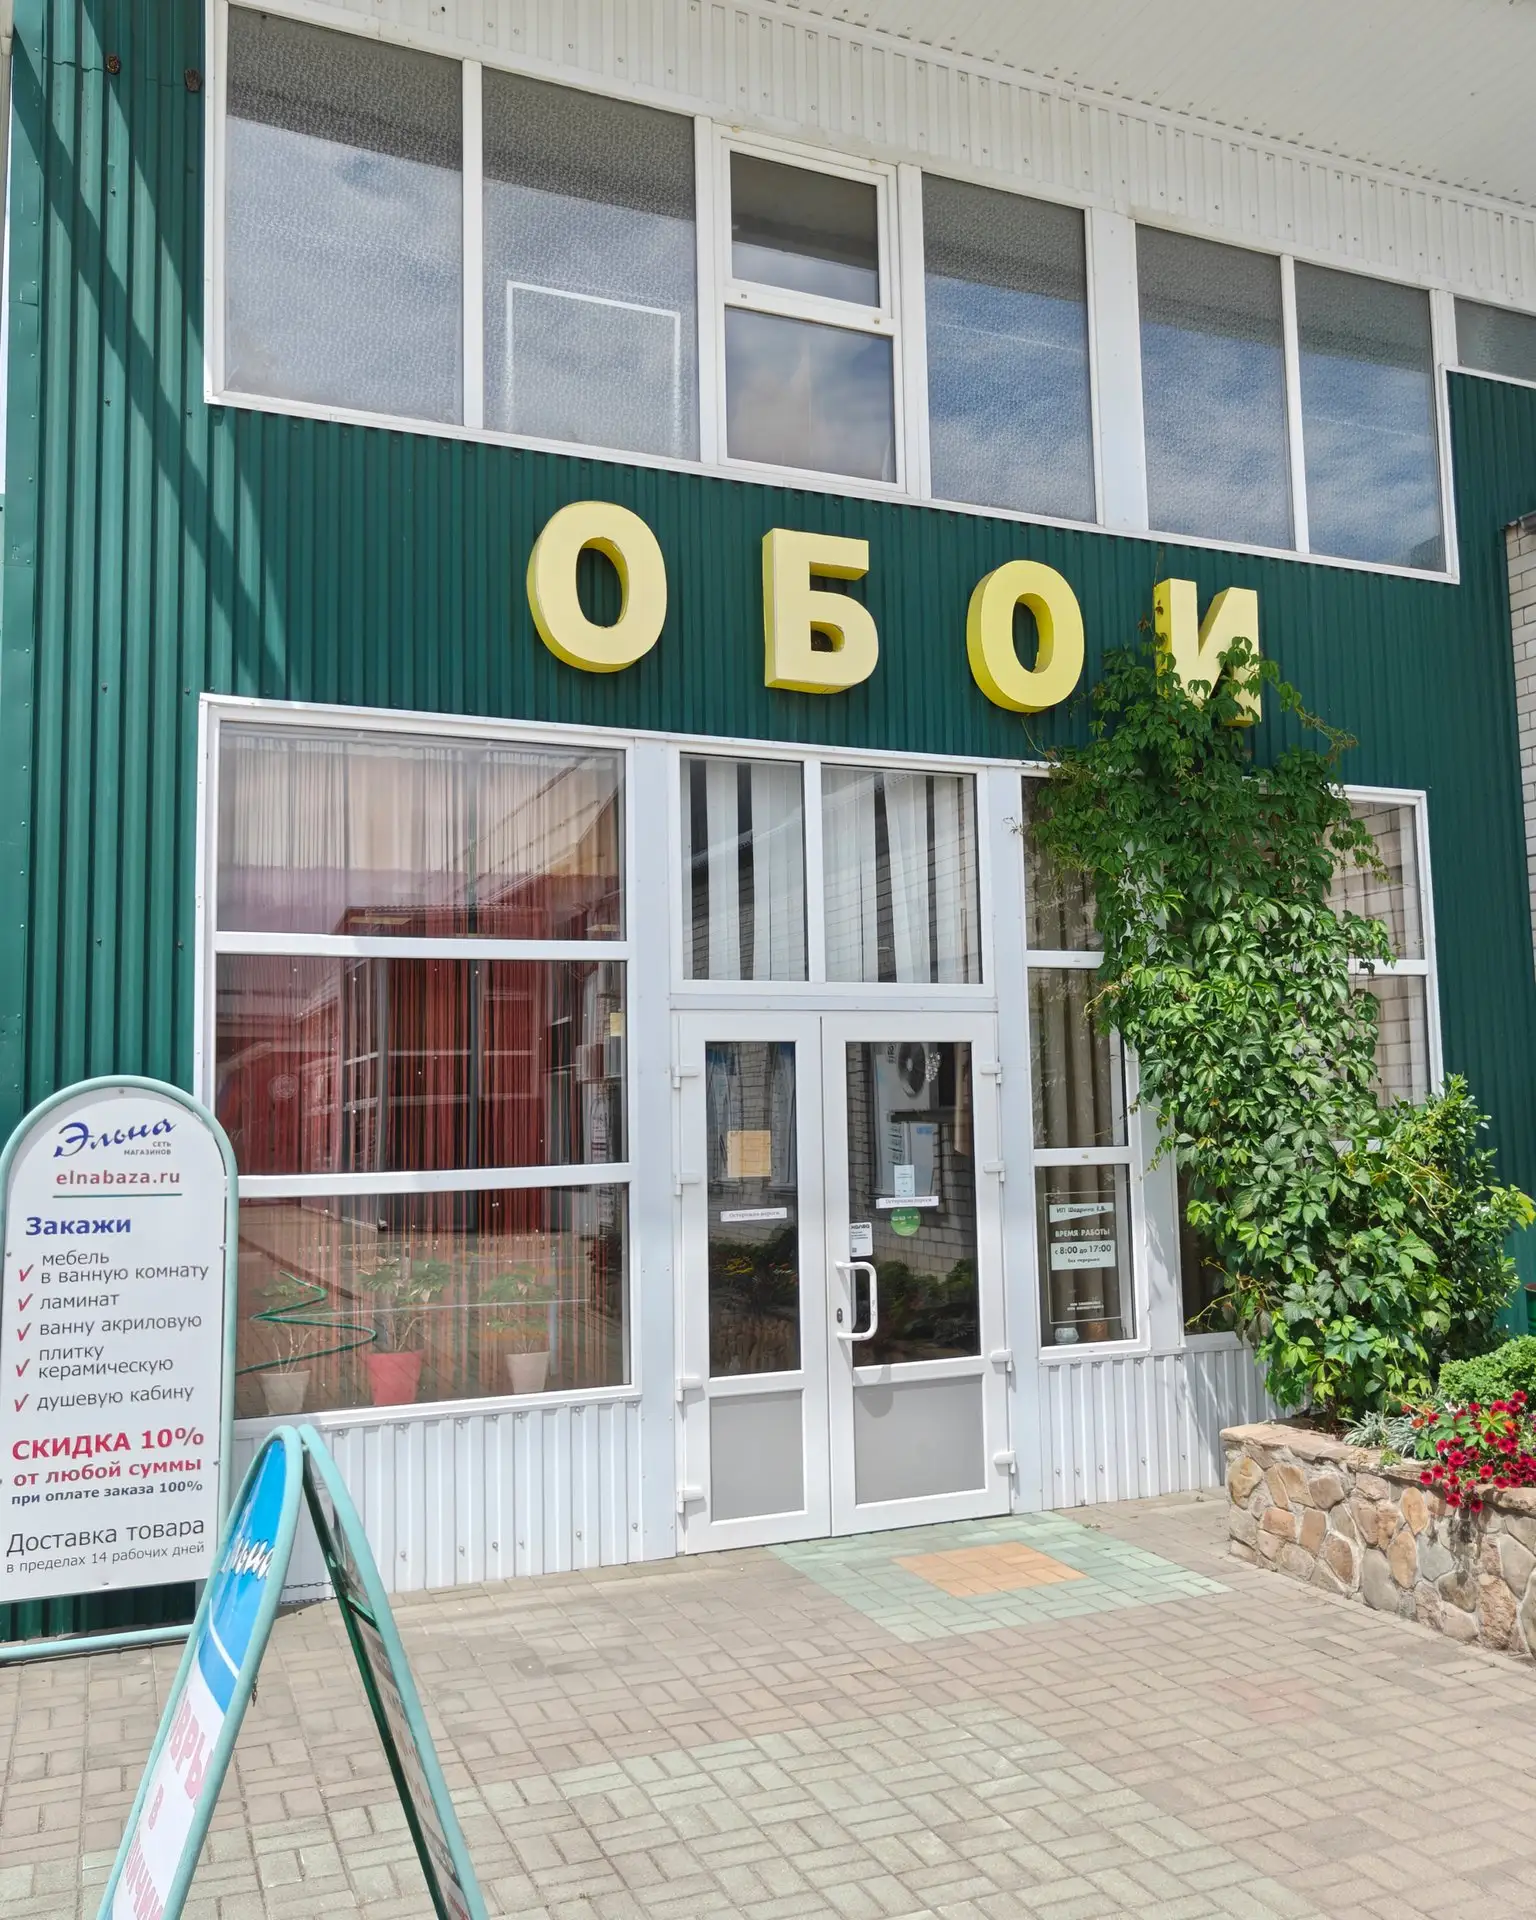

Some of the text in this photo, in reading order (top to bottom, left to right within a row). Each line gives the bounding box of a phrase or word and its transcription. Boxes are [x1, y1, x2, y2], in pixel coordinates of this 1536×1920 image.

[526, 499, 1262, 728] ОБОИ
[56, 1170, 179, 1185] elnabaza.ru
[26, 1216, 131, 1236] Закажи
[1055, 1228, 1110, 1238] ВРЕМЯ РАБОТЫ
[43, 1250, 109, 1266] мебель
[1060, 1246, 1077, 1254] 8:00
[1089, 1244, 1111, 1252] 17:00
[41, 1266, 209, 1284] в ванную комнату
[40, 1294, 120, 1309] ламинат
[40, 1316, 201, 1336] ванну акриловую
[40, 1346, 104, 1361] плитку
[39, 1359, 173, 1381] керамическую
[37, 1385, 194, 1412] душевую кабину
[12, 1427, 204, 1460] СКИДКА 10%
[14, 1459, 201, 1486] от любой суммы
[12, 1481, 202, 1507] при оплате заказа 100%
[7, 1520, 204, 1557] Доставка товара
[7, 1541, 204, 1573] в пределах 14 рабочих дней
